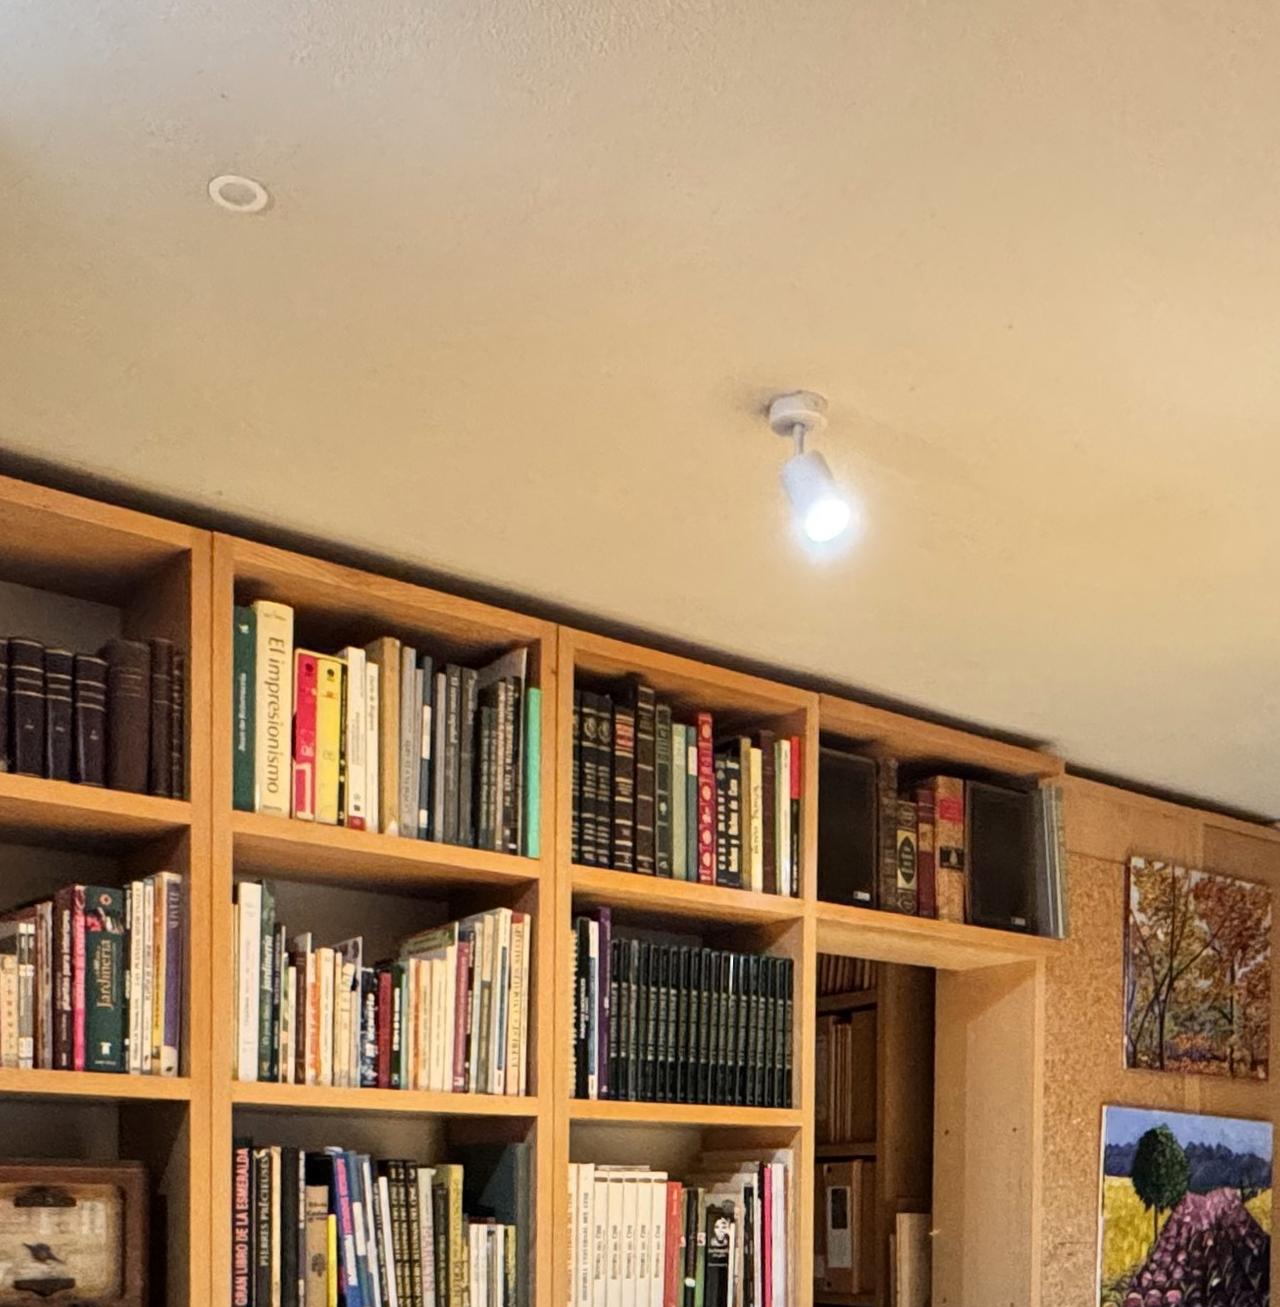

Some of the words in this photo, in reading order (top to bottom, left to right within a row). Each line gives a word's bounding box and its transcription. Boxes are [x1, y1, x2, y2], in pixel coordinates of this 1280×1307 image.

[267, 636, 284, 654] El
[265, 657, 283, 794] impresionismo
[237, 1148, 249, 1210] ESMERALDA
[237, 1212, 248, 1225] LA
[236, 1227, 248, 1241] DE
[259, 1223, 268, 1266] PIERRES
[235, 1243, 248, 1274] LIBRO
[235, 1276, 248, 1306] GRAN
